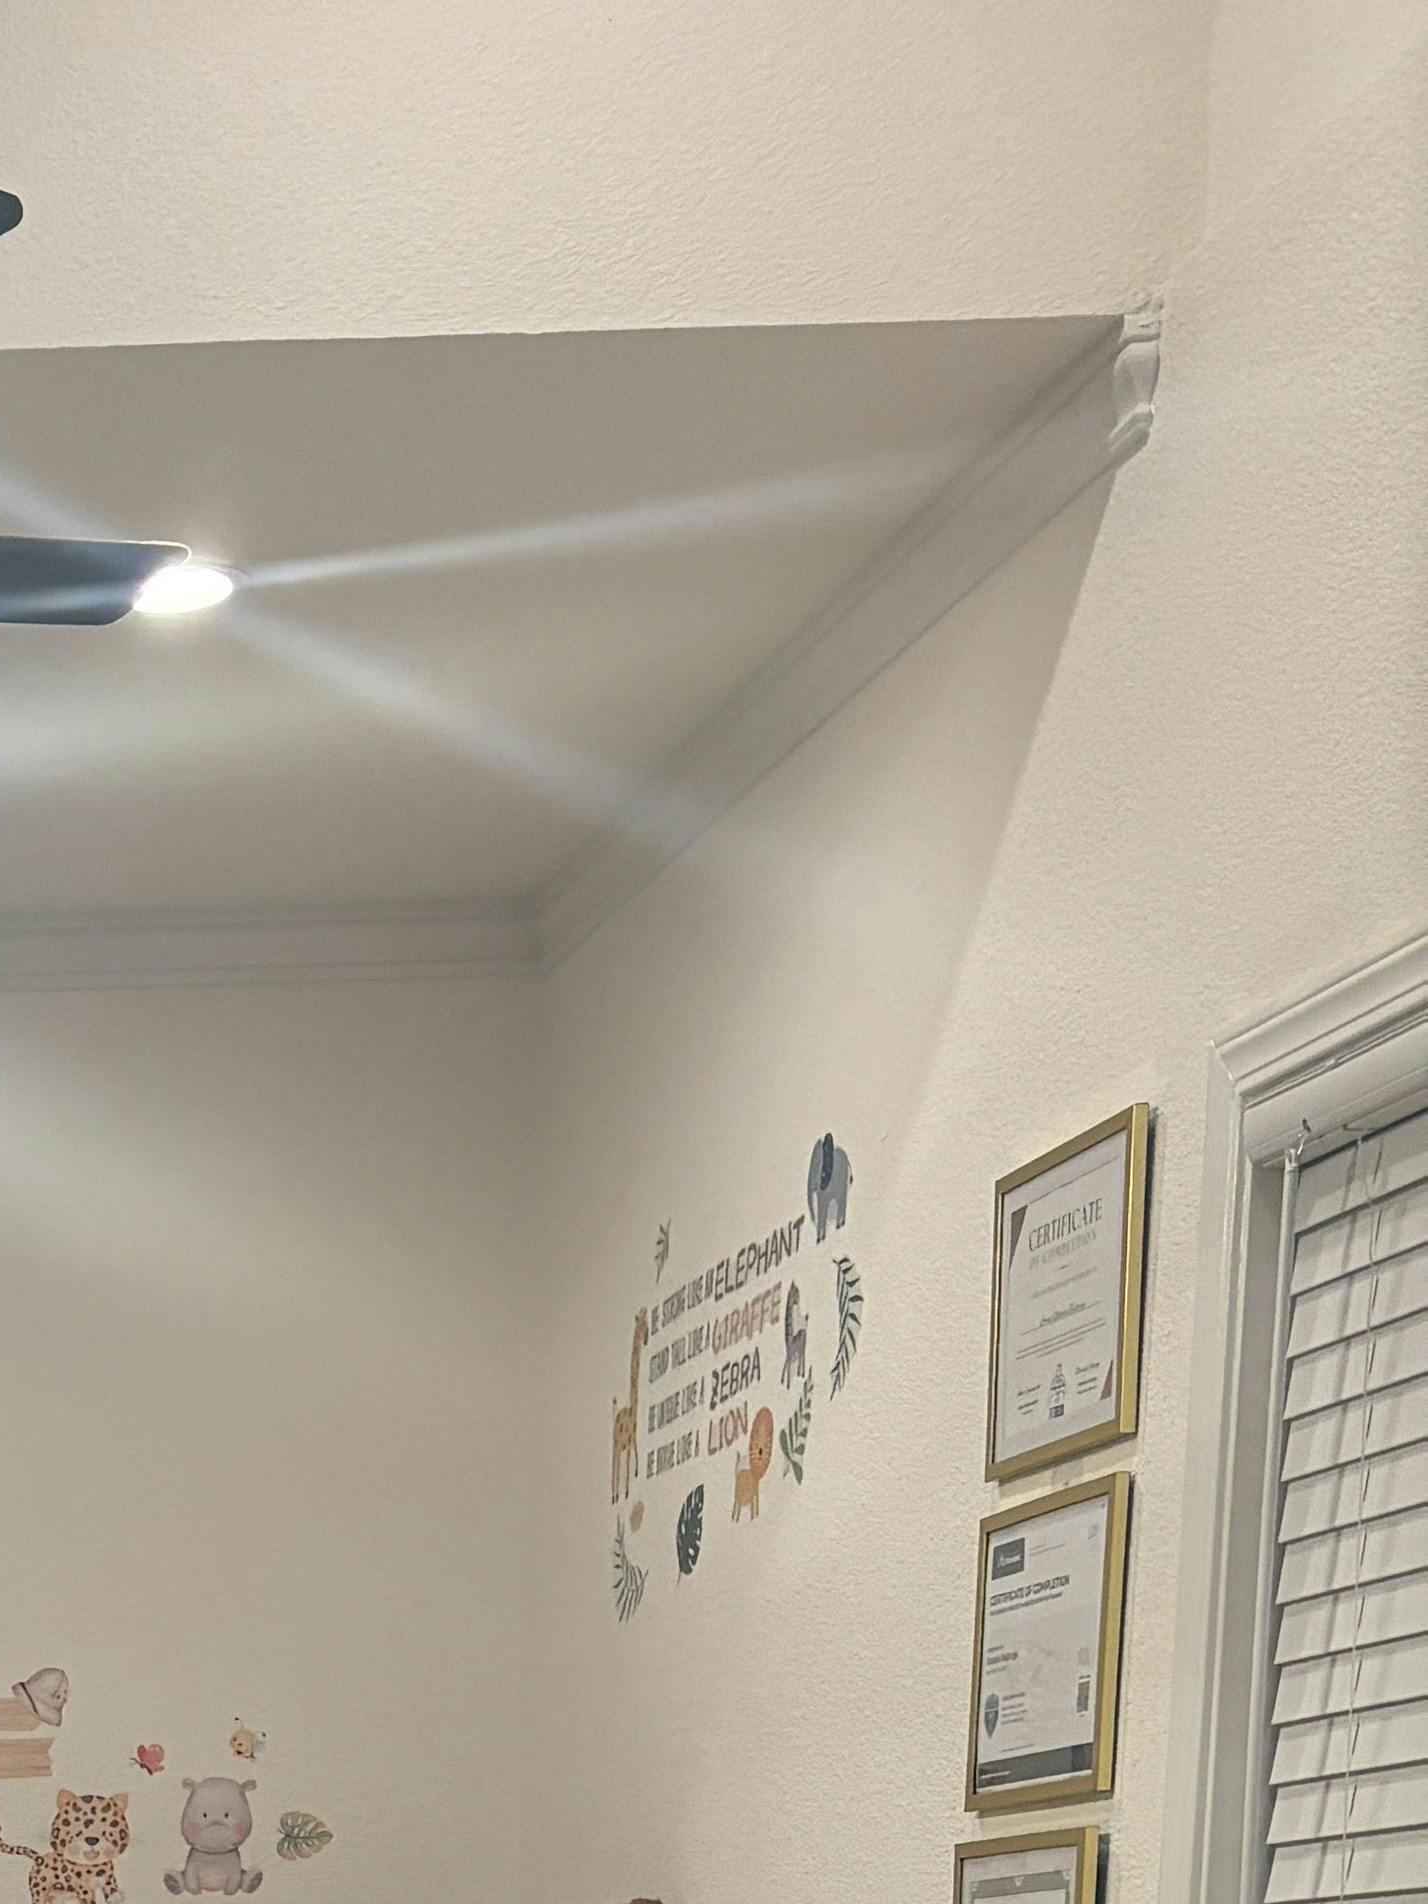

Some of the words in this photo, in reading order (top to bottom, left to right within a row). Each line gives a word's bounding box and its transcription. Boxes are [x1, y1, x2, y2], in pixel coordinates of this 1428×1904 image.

[1028, 1197, 1103, 1252] CERTIFICATE
[714, 1214, 806, 1302] ELEPHANT
[711, 1280, 783, 1355] GIRAFFE
[709, 1346, 761, 1410] ZEBRA
[707, 1400, 749, 1456] LION
